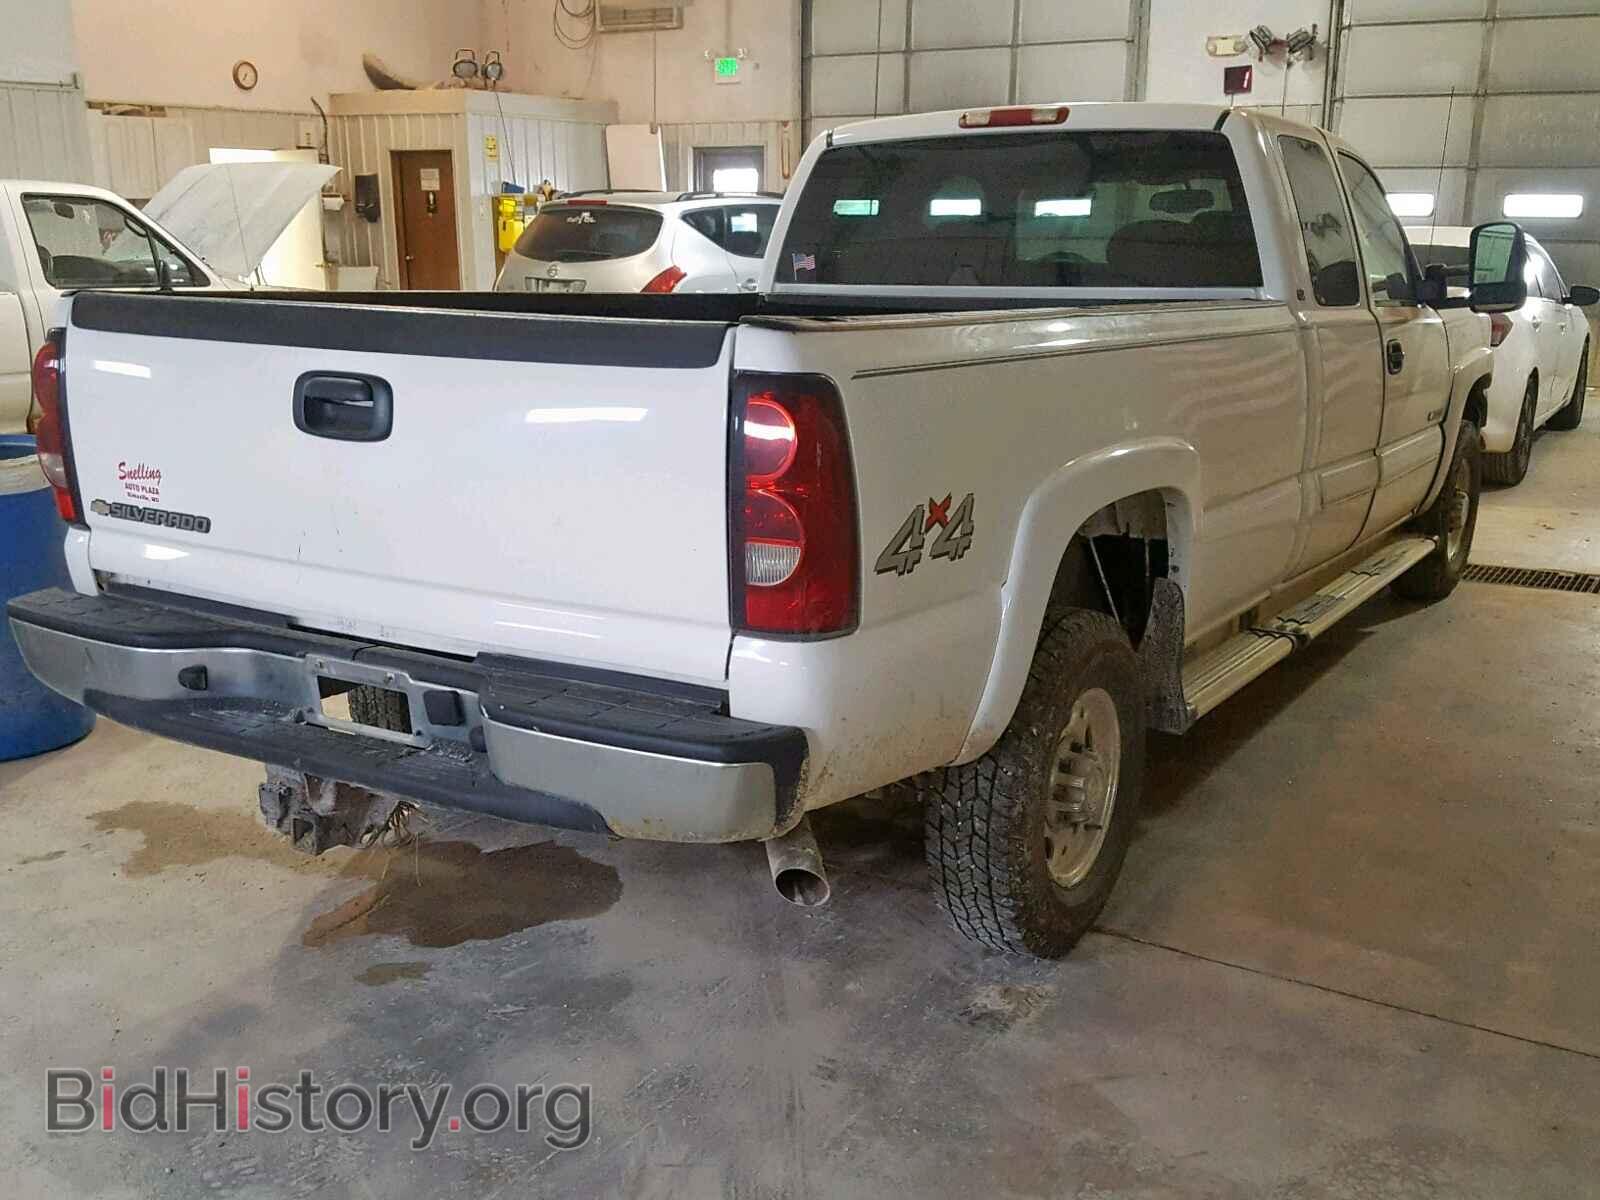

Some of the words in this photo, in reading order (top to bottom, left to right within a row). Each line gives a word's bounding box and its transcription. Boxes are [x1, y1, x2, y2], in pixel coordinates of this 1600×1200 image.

[118, 461, 162, 486] Snelling
[124, 482, 142, 493] AUTO
[141, 485, 160, 496] PLAZA
[110, 503, 209, 533] SILVERADO
